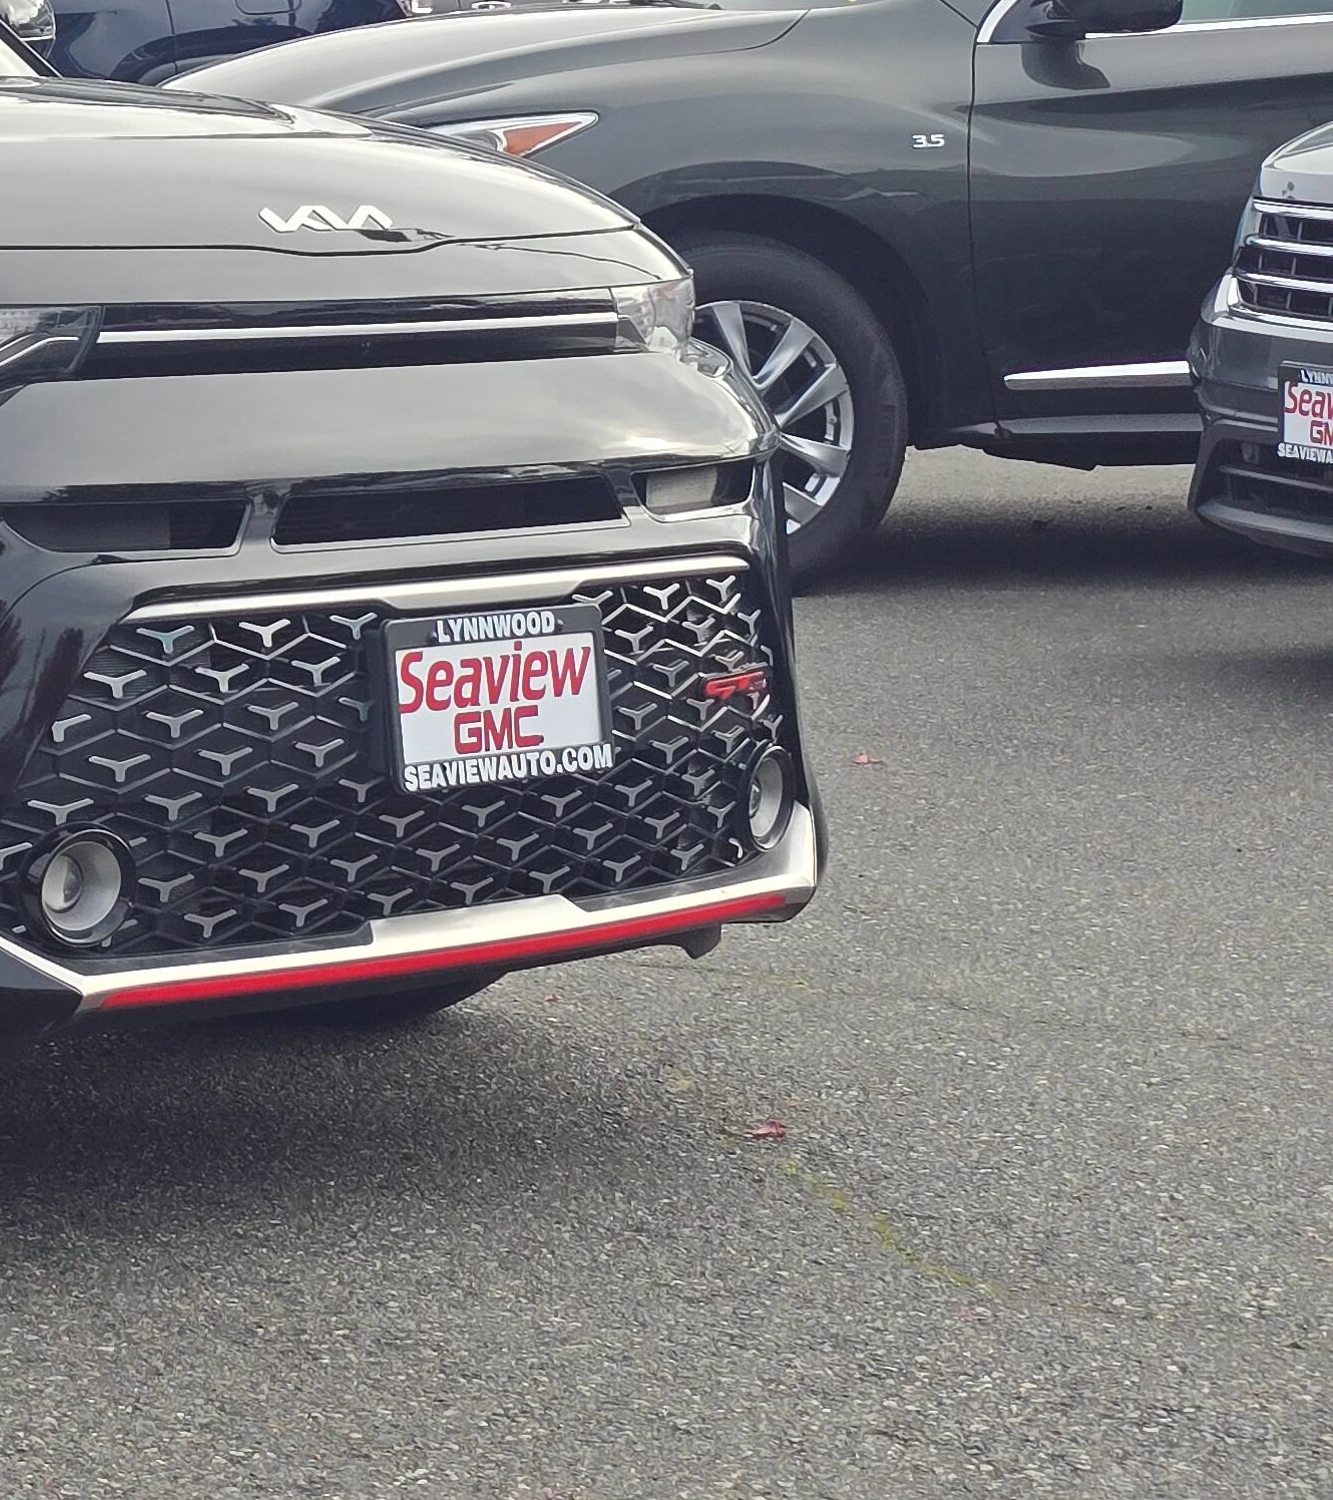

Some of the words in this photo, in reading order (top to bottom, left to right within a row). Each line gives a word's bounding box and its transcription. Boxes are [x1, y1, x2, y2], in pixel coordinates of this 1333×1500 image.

[436, 611, 555, 643] LYNNWOOD
[399, 640, 591, 714] Seaview
[454, 705, 544, 755] GMC
[404, 744, 613, 792] SEAVIEWAUTO.COM
